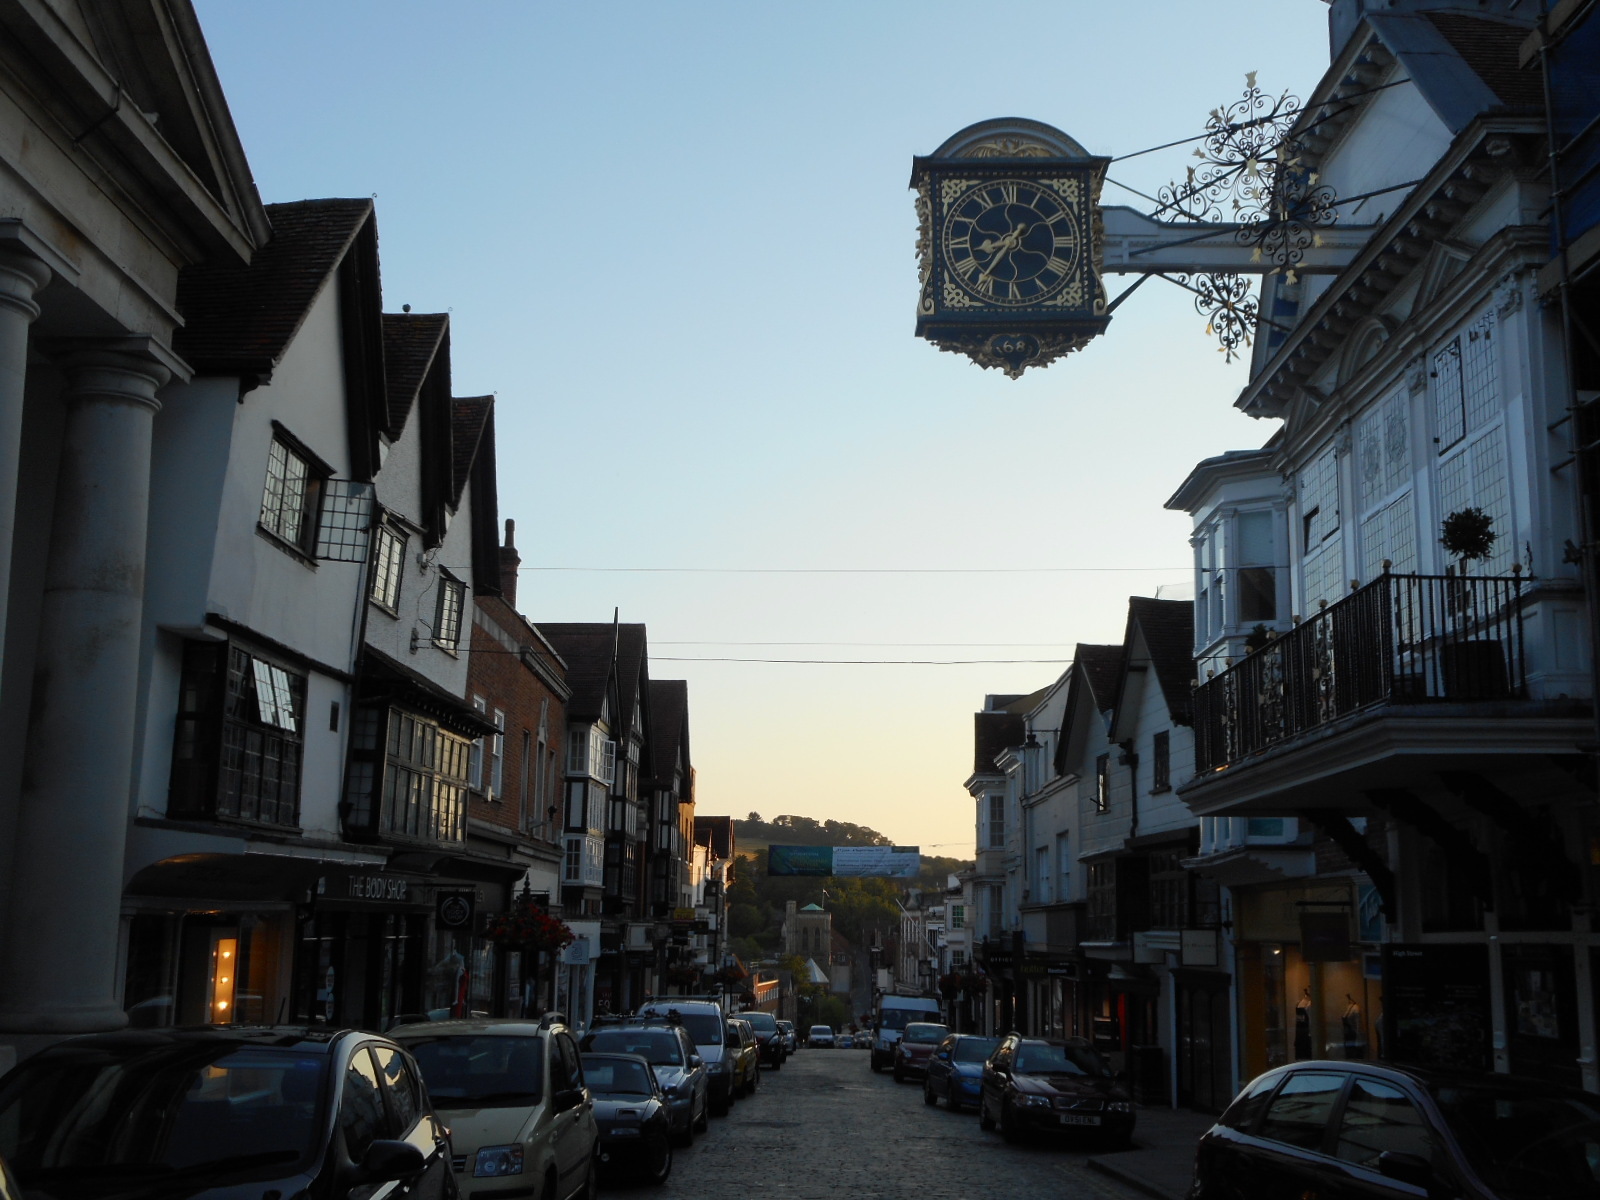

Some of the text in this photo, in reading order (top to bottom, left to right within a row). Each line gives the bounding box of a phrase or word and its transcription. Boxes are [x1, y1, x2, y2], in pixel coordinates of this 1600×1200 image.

[348, 875, 407, 900] THE BODY SHOP
